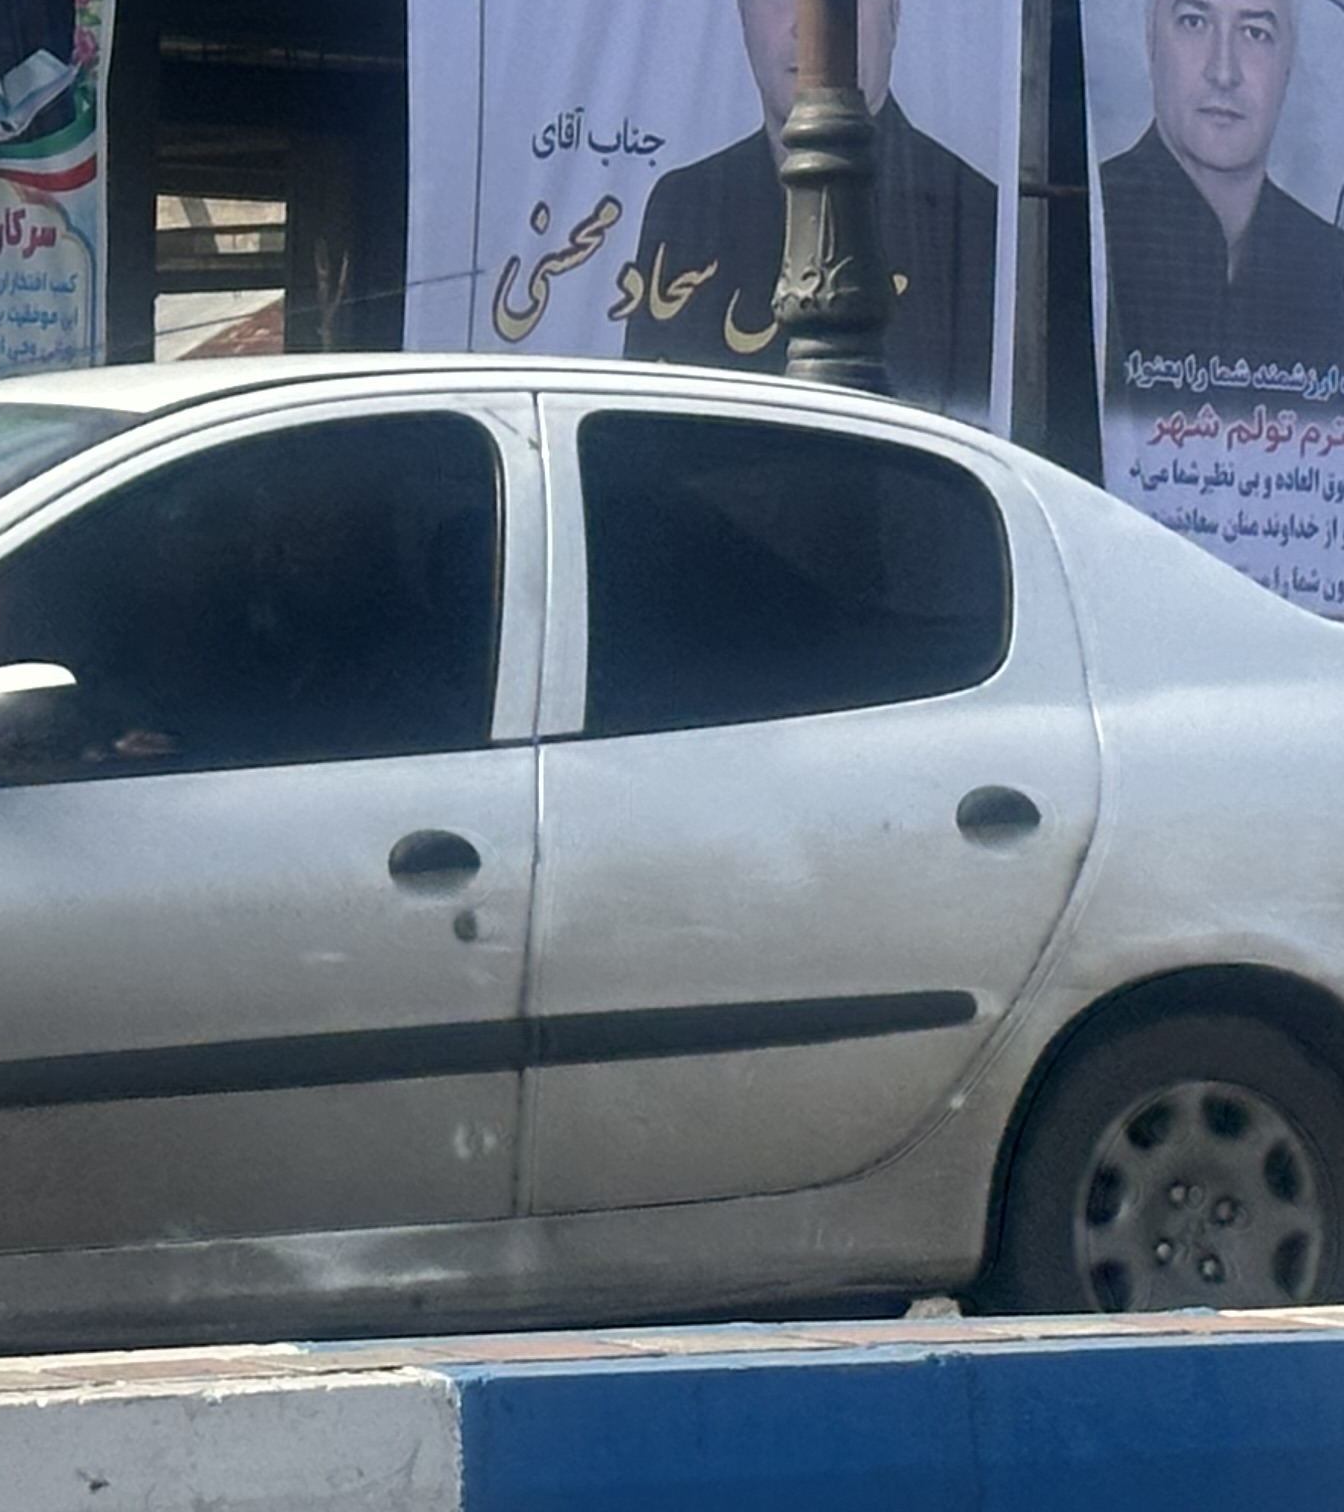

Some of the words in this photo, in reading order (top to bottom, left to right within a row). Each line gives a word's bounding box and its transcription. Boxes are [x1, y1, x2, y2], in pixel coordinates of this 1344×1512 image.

[531, 108, 585, 161] آقای
[588, 120, 665, 167] جناب
[493, 194, 622, 341] محسنی
[1184, 354, 1207, 391] را
[1210, 356, 1252, 387] شما
[1253, 363, 1339, 401] ارزشمند
[1147, 402, 1219, 448] شهر
[1227, 404, 1296, 452] تولم
[1262, 476, 1272, 499] و
[1262, 511, 1320, 547] خداوند
[1323, 517, 1338, 549] از
